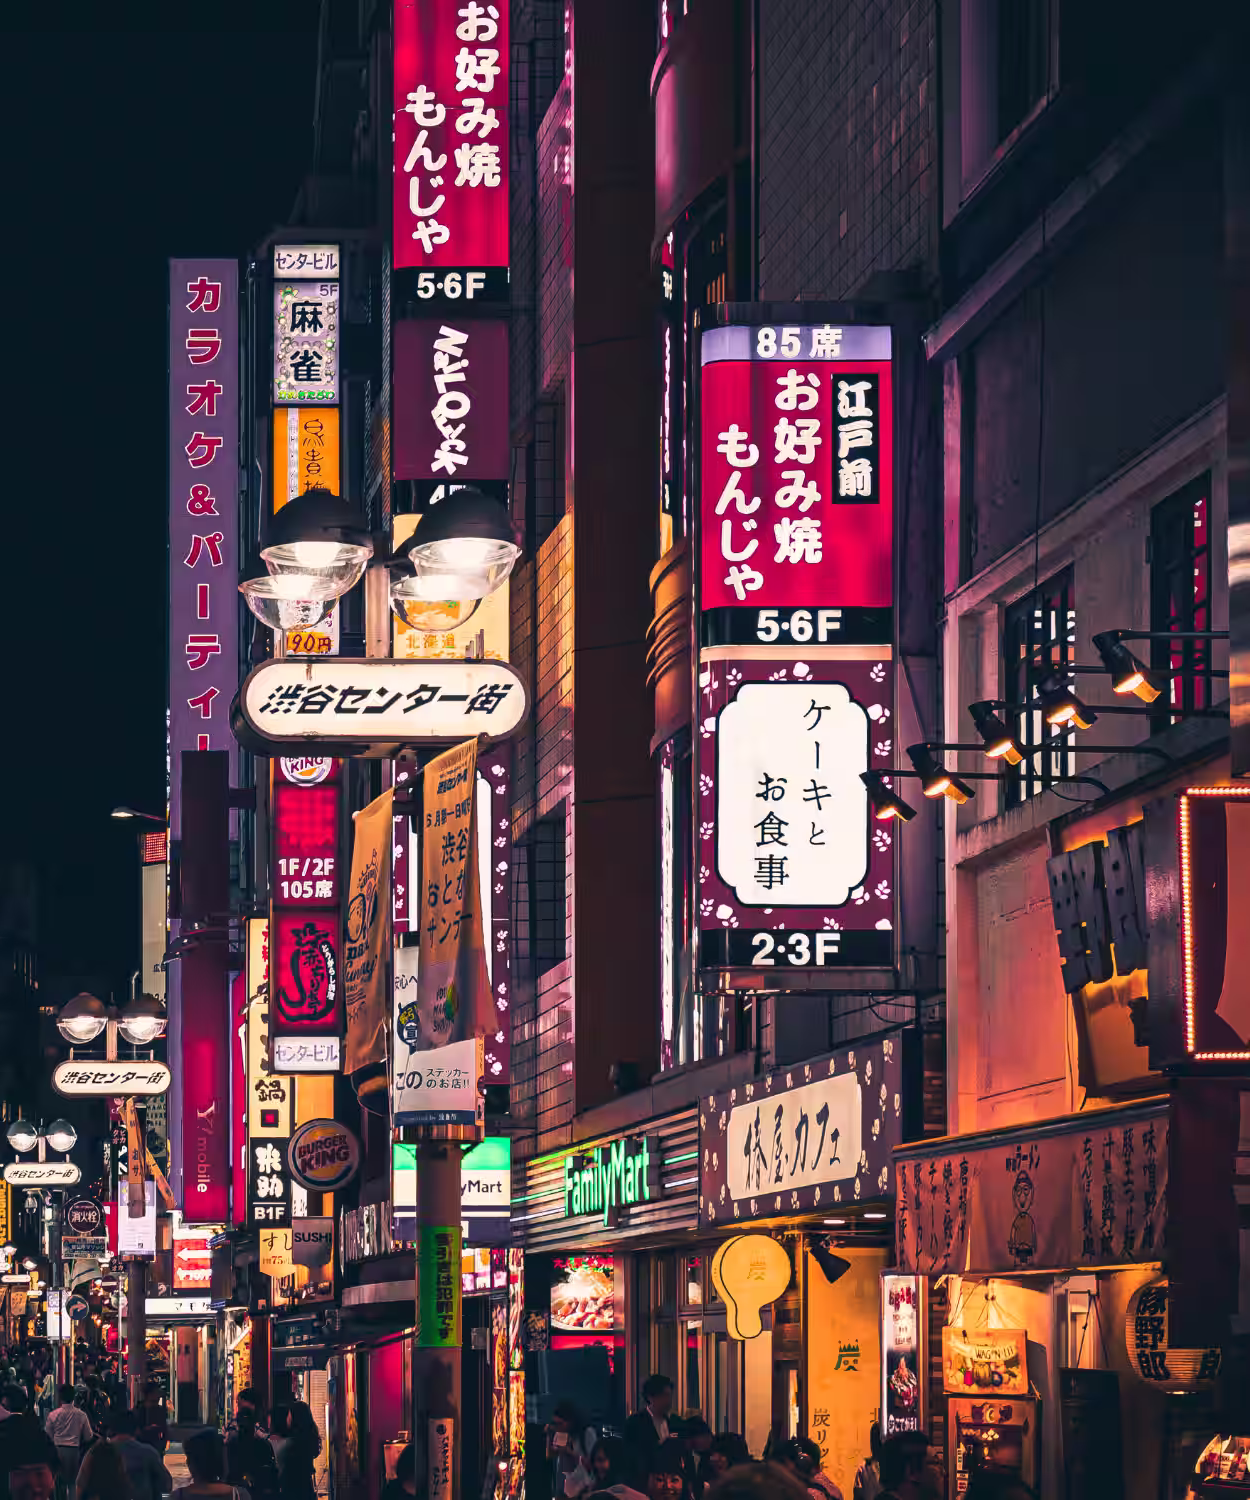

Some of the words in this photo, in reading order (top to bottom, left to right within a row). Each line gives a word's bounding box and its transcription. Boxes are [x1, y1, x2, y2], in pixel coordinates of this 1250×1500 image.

[454, 1, 500, 187] お好み焼
[403, 85, 450, 254] もんじゃ
[275, 252, 338, 270] センタービル
[320, 284, 339, 297] 5F
[289, 300, 323, 382] 麻雀
[837, 380, 874, 497] 江戸前
[774, 368, 823, 564] お好み焼
[715, 423, 765, 601] もんじゃ
[259, 684, 515, 715] 渋谷センター街
[802, 699, 832, 846] ケーキと
[753, 772, 791, 890] お食事
[280, 880, 333, 898] 105席
[276, 1044, 340, 1063] センタービル
[61, 1071, 167, 1085] 渋谷センター街
[426, 1067, 469, 1077] ステッカー
[297, 1133, 348, 1159] BURGER
[8, 1168, 76, 1180] 渋谷センター街
[299, 1147, 350, 1175] KING
[564, 1138, 650, 1228] FamilyMart
[71, 1211, 98, 1223] 消火栓
[254, 1206, 286, 1220] B1F
[293, 1231, 333, 1243] SUSHI
